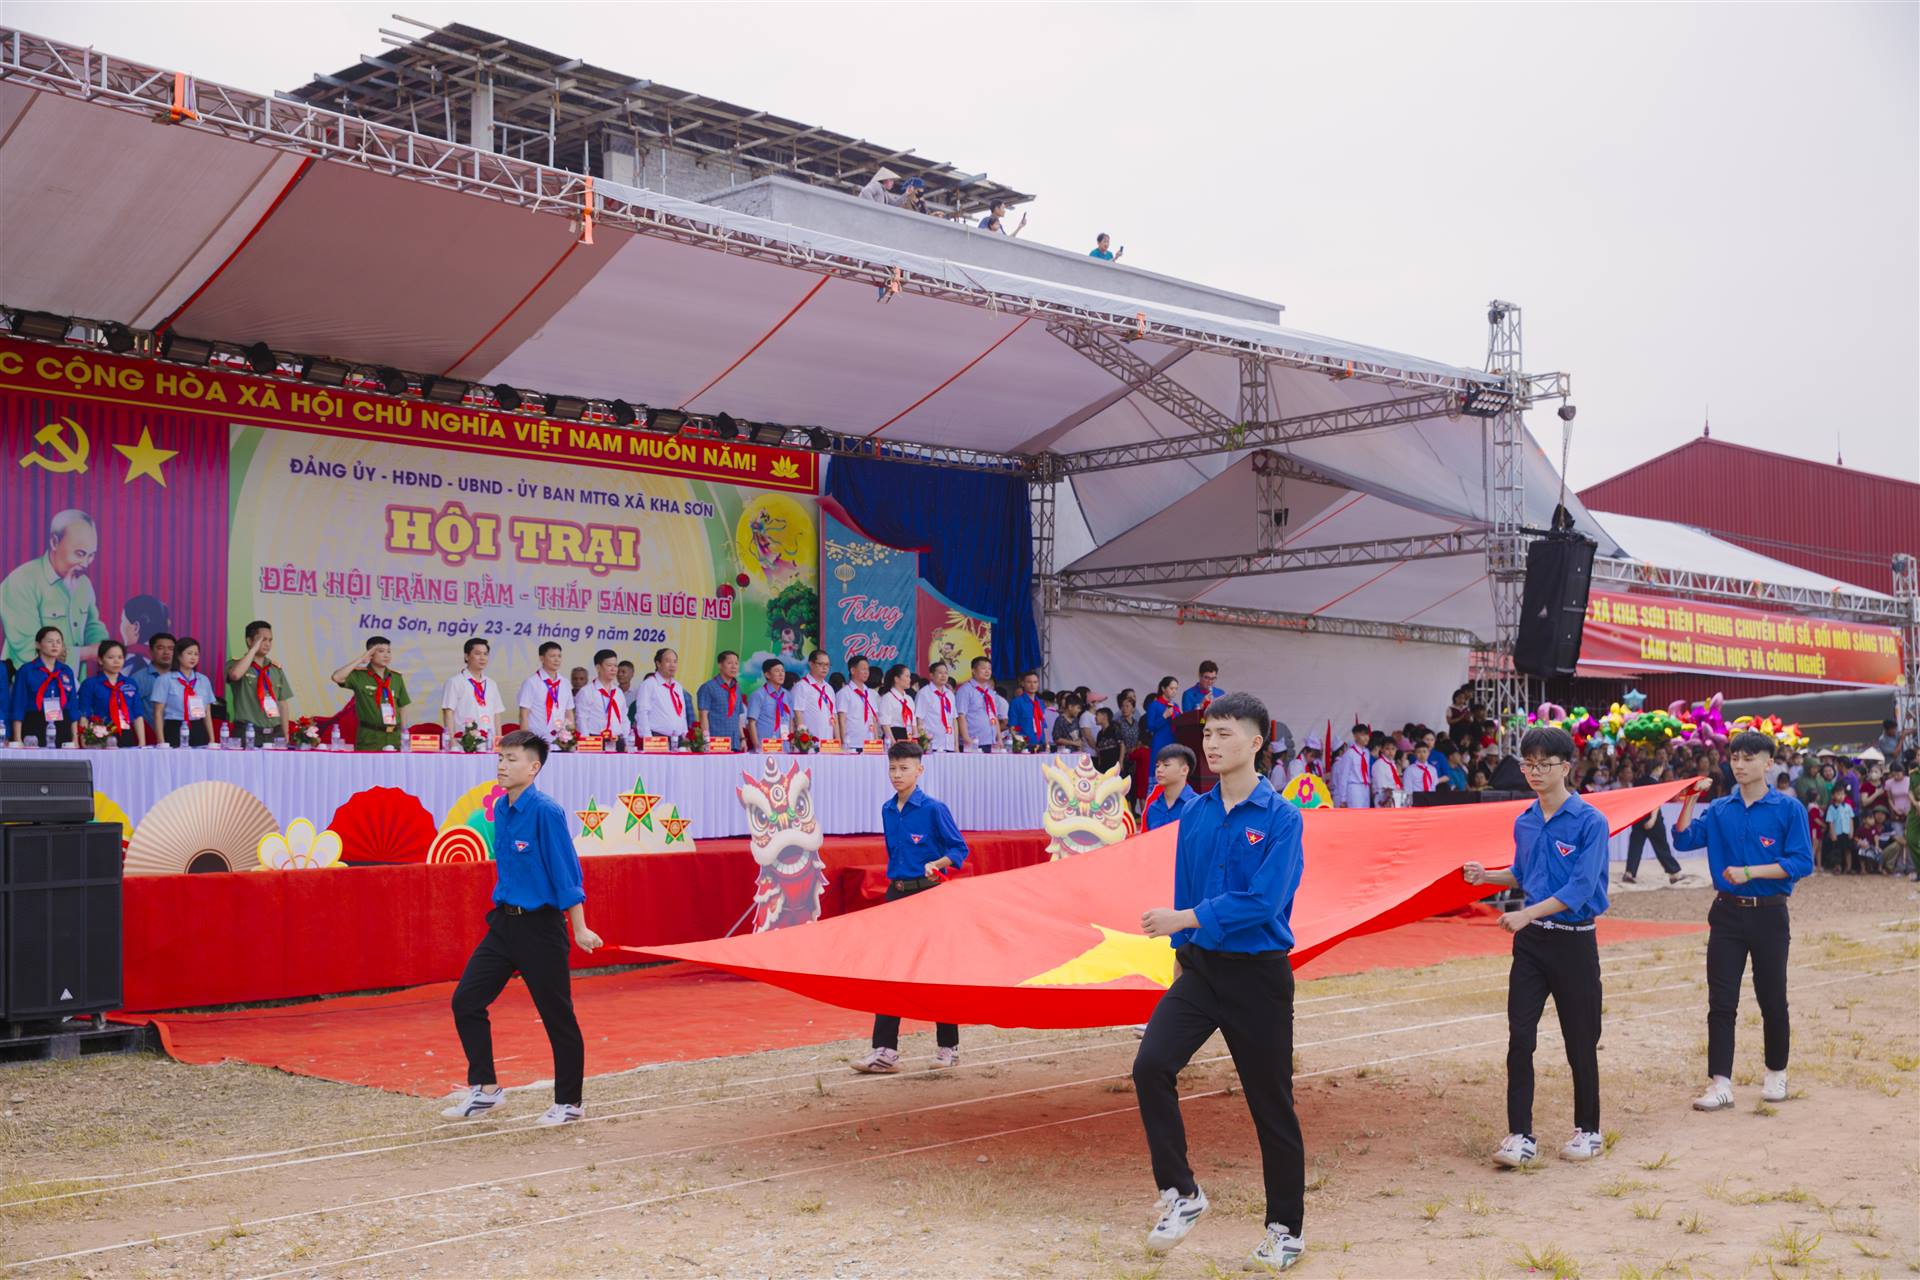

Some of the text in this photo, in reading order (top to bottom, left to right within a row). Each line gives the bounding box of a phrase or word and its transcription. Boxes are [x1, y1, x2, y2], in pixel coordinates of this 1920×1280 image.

[36, 356, 145, 391] CỘNG
[156, 371, 227, 403] HÒA
[238, 384, 281, 410] XÃ
[291, 390, 343, 422] HỘI
[353, 401, 412, 427] CHỦ
[421, 410, 505, 439] NGHĨA
[514, 420, 562, 449] VIỆT
[569, 429, 622, 454] NAM
[630, 437, 696, 463] MUÔN
[704, 445, 757, 472] NĂM!
[290, 455, 347, 479] ĐẢNG
[353, 460, 376, 481] ỦY
[392, 470, 442, 488] HĐND
[458, 477, 503, 495] UBND
[517, 478, 537, 498] ỦY
[543, 486, 574, 502] BAN
[580, 490, 620, 507] MTTQ
[624, 493, 645, 510] XÃ
[650, 497, 680, 514] KHA
[684, 501, 713, 517] SƠN
[387, 502, 639, 575] HỘI TRẠI
[261, 564, 317, 593] ĐÊM
[325, 568, 371, 603] HỘI
[379, 572, 458, 604] TRĂNG
[465, 574, 514, 607] RẰM
[536, 580, 592, 611] THẮP
[598, 588, 652, 615] SÁNG
[658, 592, 697, 618] ƯỚC
[703, 596, 733, 620] MƠ
[838, 594, 903, 630] Trăng
[359, 614, 392, 630] Kha
[397, 615, 432, 635] Sơn,
[437, 618, 478, 636] ngày
[537, 623, 580, 642] tháng
[585, 626, 593, 639] 9
[597, 625, 628, 641] năm
[633, 628, 666, 643] 2026
[843, 632, 898, 662] Rằm
[1592, 597, 1610, 623] XÃ
[1613, 602, 1638, 626] KHA
[1641, 605, 1666, 629] SƠN
[1668, 606, 1693, 632] TIÊN
[1696, 612, 1733, 637] PHONG
[1735, 614, 1776, 641] CHUYỂN
[1832, 627, 1851, 650] MỚI
[1853, 630, 1877, 652] SÁNG
[1640, 635, 1826, 679] LÀM CHỦ KHOA HỌC VÀ CÔNG NGHỆ!
